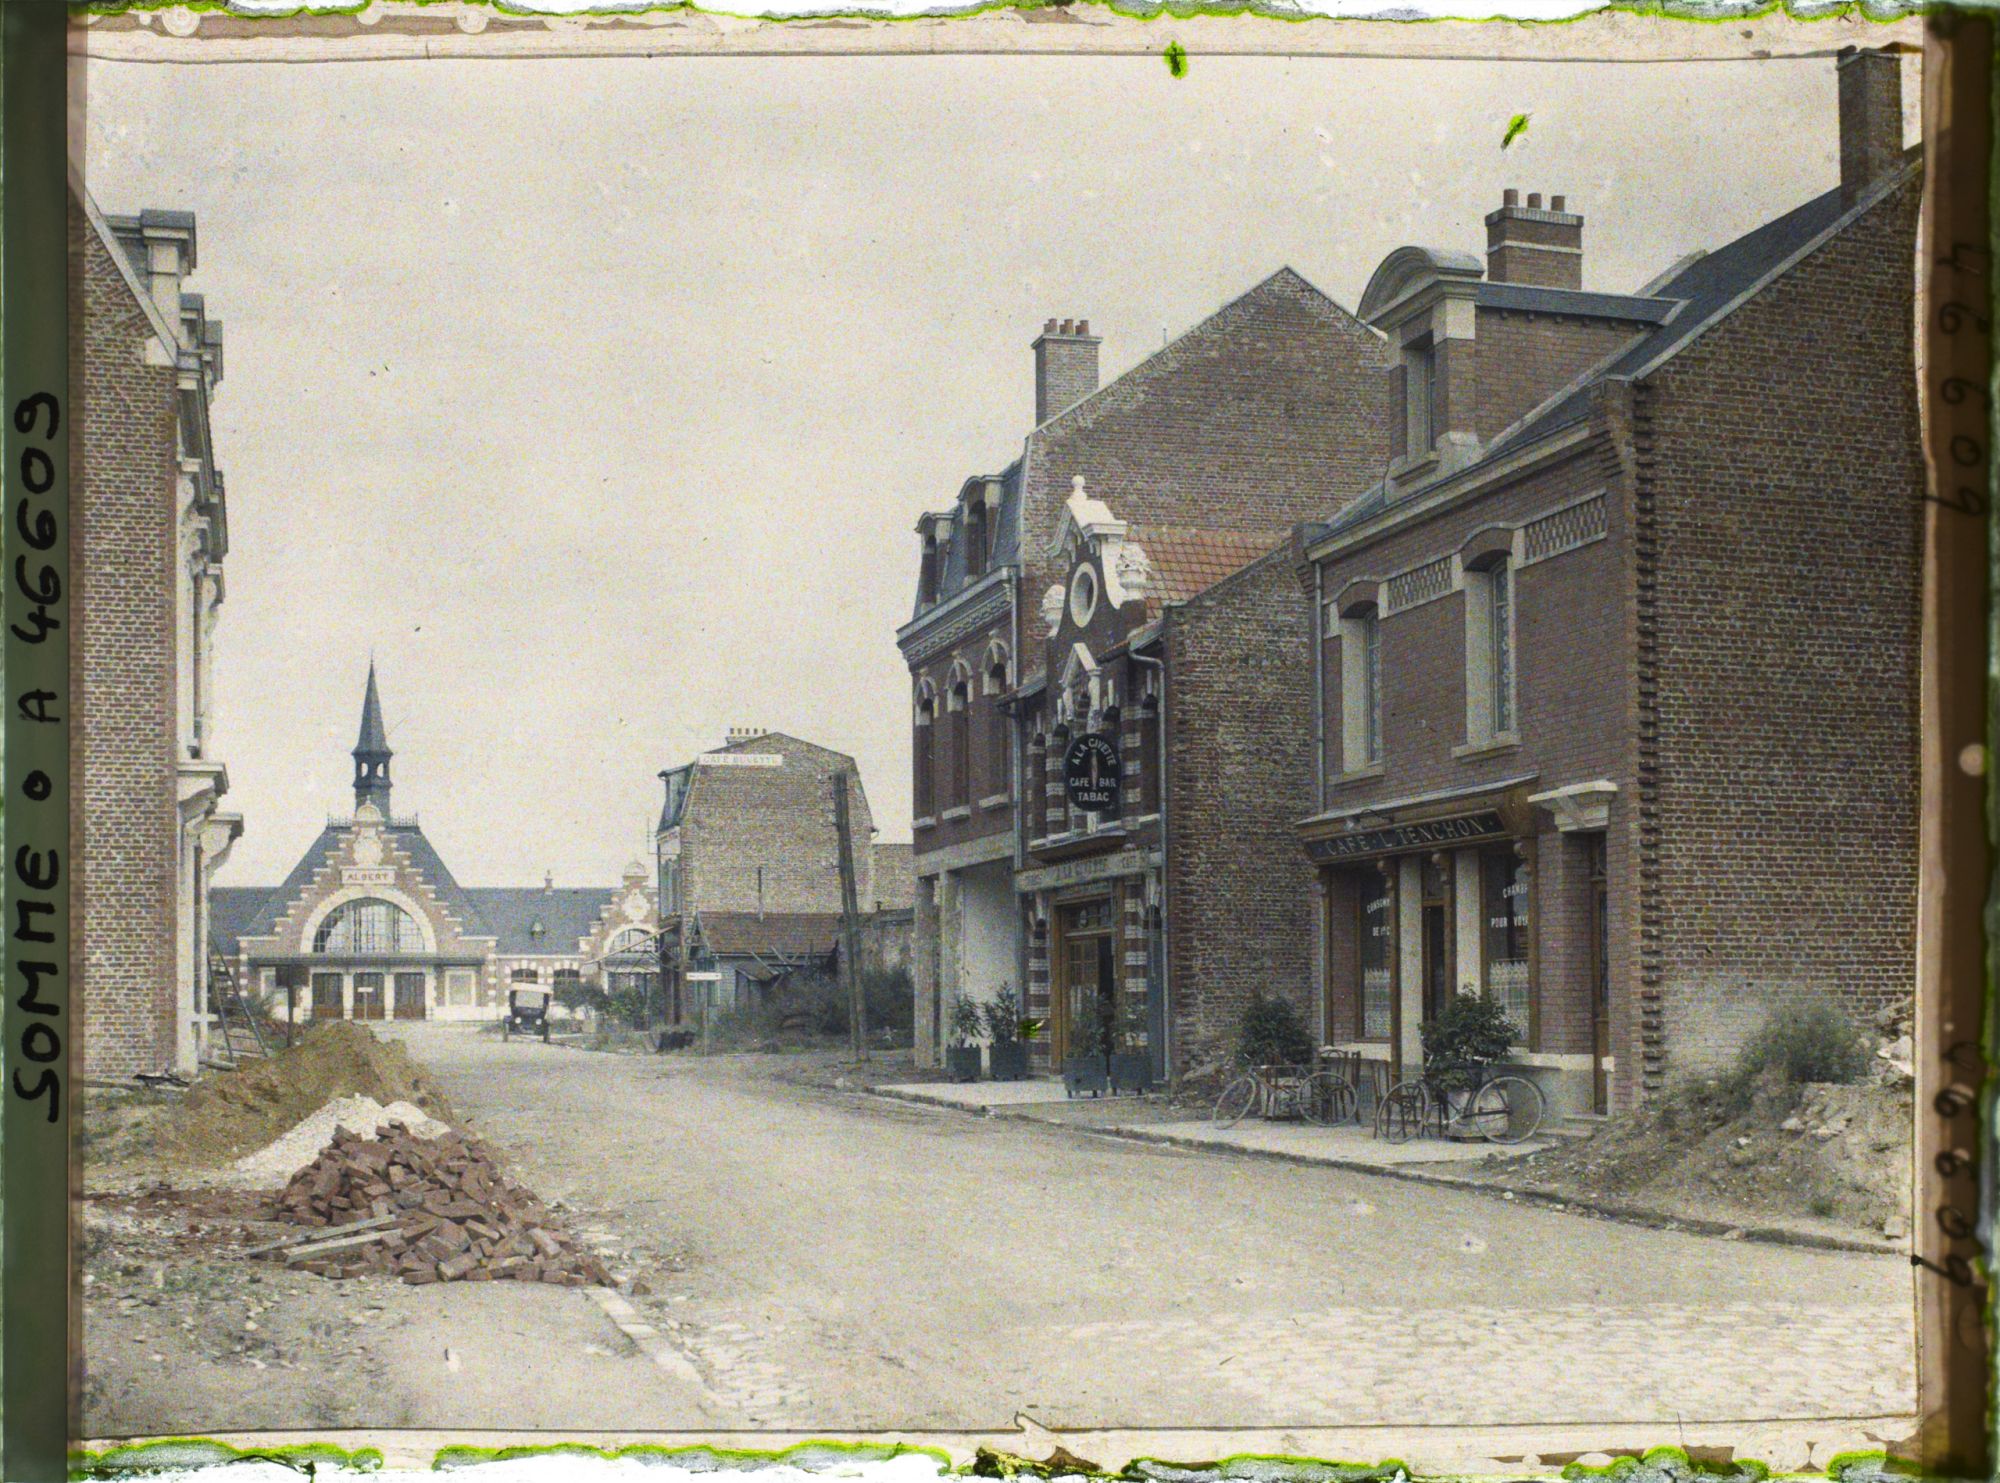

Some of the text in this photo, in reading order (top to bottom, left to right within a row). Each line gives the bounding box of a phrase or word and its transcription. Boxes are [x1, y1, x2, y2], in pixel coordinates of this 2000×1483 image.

[10, 391, 61, 644] 46609
[18, 689, 61, 722] A
[1074, 743, 1090, 758] LA
[1088, 738, 1117, 767] CIVETTE
[1077, 791, 1110, 802] TABAC
[1099, 777, 1117, 788] BAR
[1395, 817, 1486, 846] TENCHON
[347, 872, 389, 881] ALBERT
[1490, 916, 1508, 928] POUR
[12, 844, 60, 1124] SOMME
